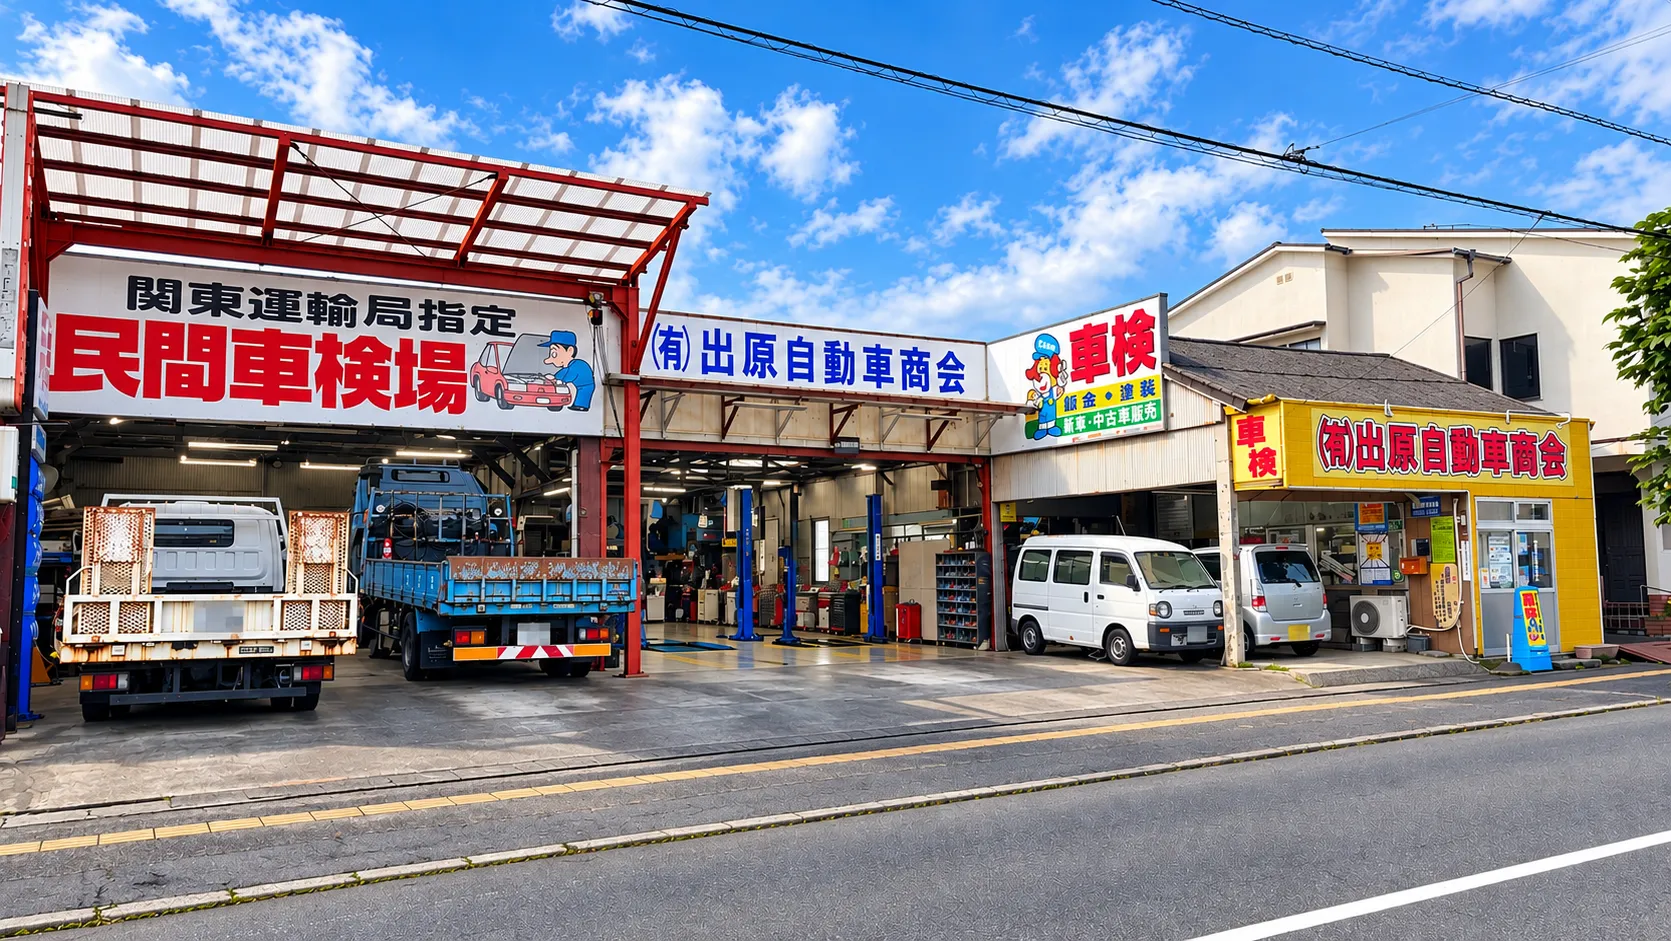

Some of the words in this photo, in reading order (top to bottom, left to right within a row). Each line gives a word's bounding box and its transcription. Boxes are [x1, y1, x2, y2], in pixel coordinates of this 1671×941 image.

[126, 275, 516, 338] 関東運輸局指定
[49, 312, 469, 415] 民間車検場
[1069, 308, 1156, 384] 車検
[1063, 401, 1157, 433] 新車・中古車販売
[1236, 414, 1277, 478] 車検
[1317, 415, 1568, 480] (有)出原自動車商会
